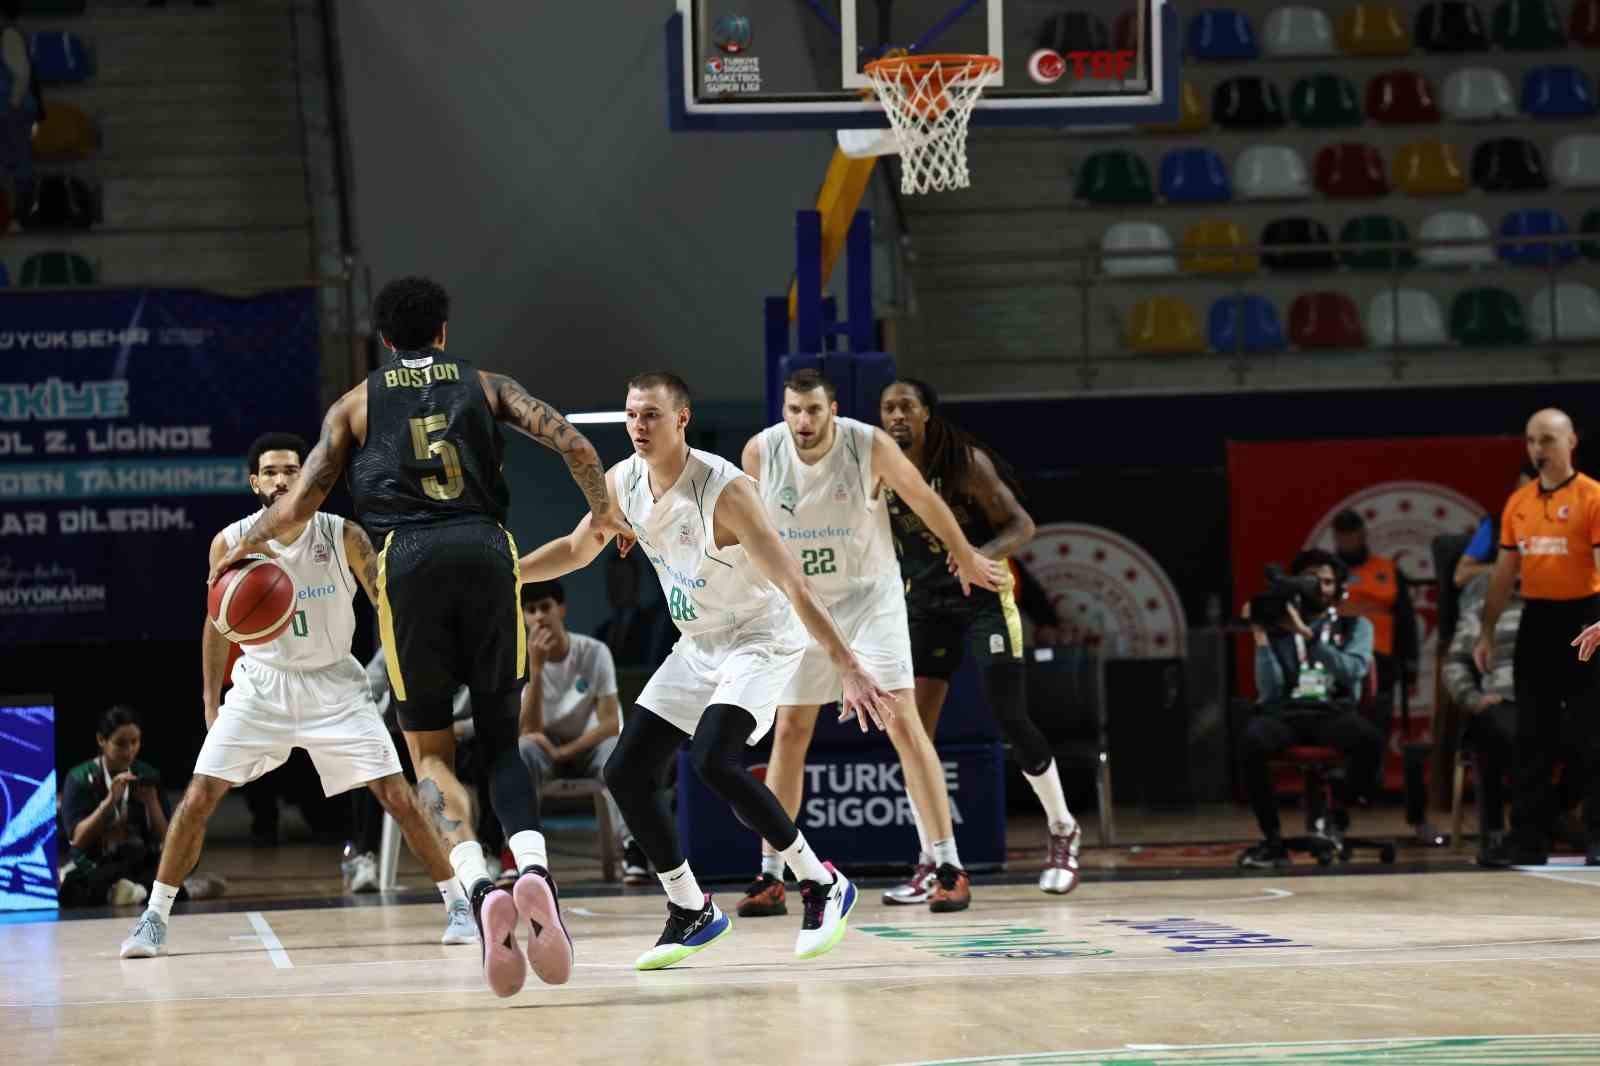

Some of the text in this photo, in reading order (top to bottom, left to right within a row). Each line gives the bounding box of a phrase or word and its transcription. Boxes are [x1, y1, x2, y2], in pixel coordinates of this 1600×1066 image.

[384, 363, 460, 388] BOSTON
[409, 413, 465, 500] 5
[801, 547, 837, 576] 22
[805, 761, 959, 793] TÜRKE
